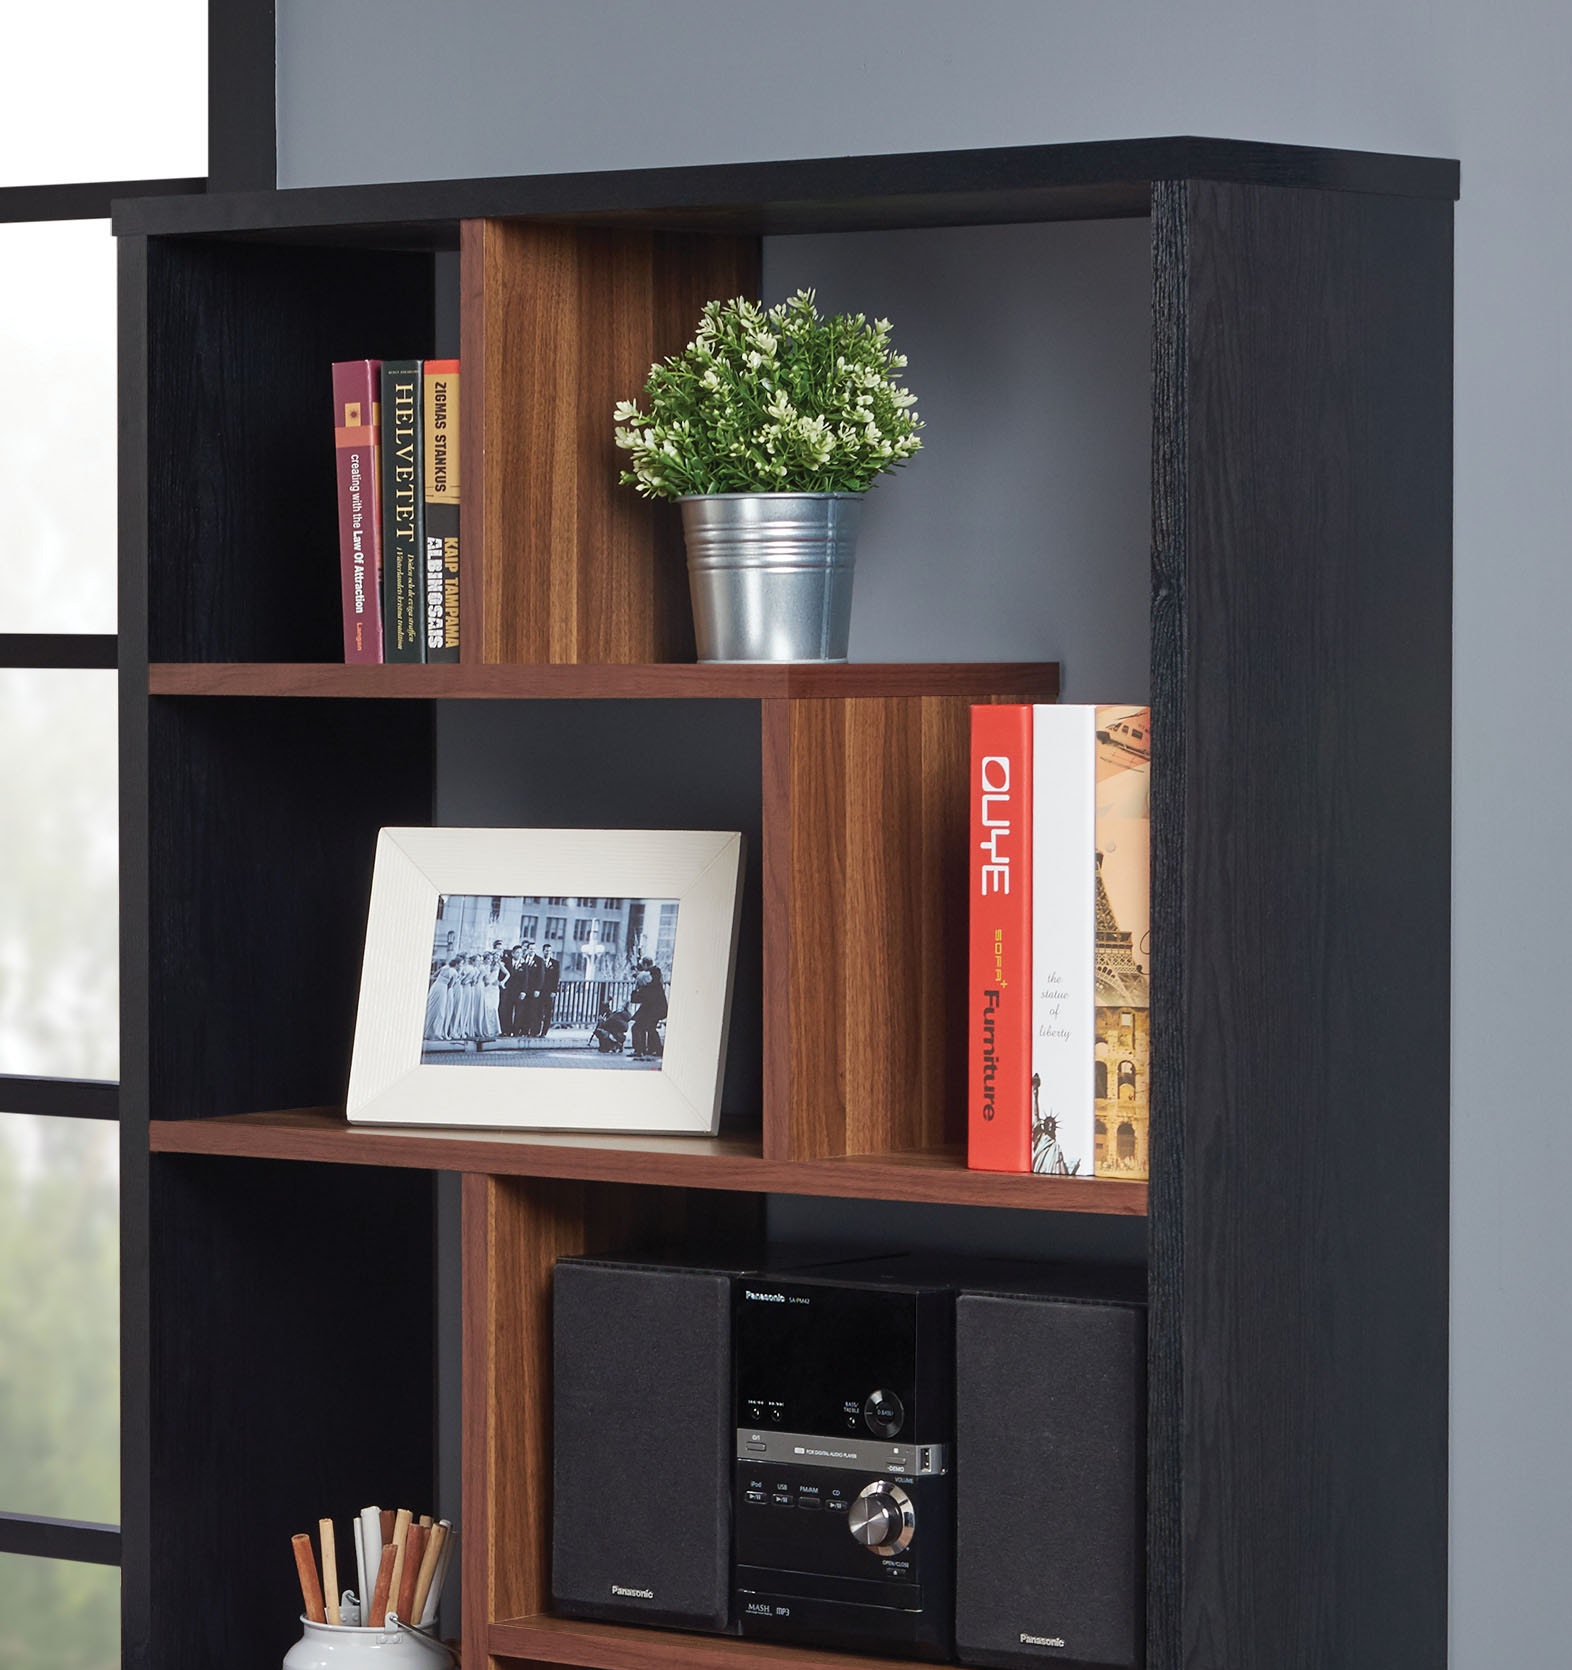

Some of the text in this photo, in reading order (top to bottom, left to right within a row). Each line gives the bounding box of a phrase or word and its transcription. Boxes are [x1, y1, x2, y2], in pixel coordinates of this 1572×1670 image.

[395, 384, 415, 542] HELVETET
[435, 382, 447, 492] ZIGMAS STANKUS
[349, 454, 365, 613] creating with the Law Of Attraction
[427, 537, 443, 649] ALBINOSAIS
[444, 537, 460, 648] KAIP TAMPAMA
[1047, 971, 1061, 984] the
[1049, 1003, 1060, 1020] of
[982, 990, 1000, 1122] Furniture
[1039, 1024, 1071, 1042] liberty
[611, 1585, 654, 1599] Panasonic
[1020, 1633, 1065, 1647] Panasonic
